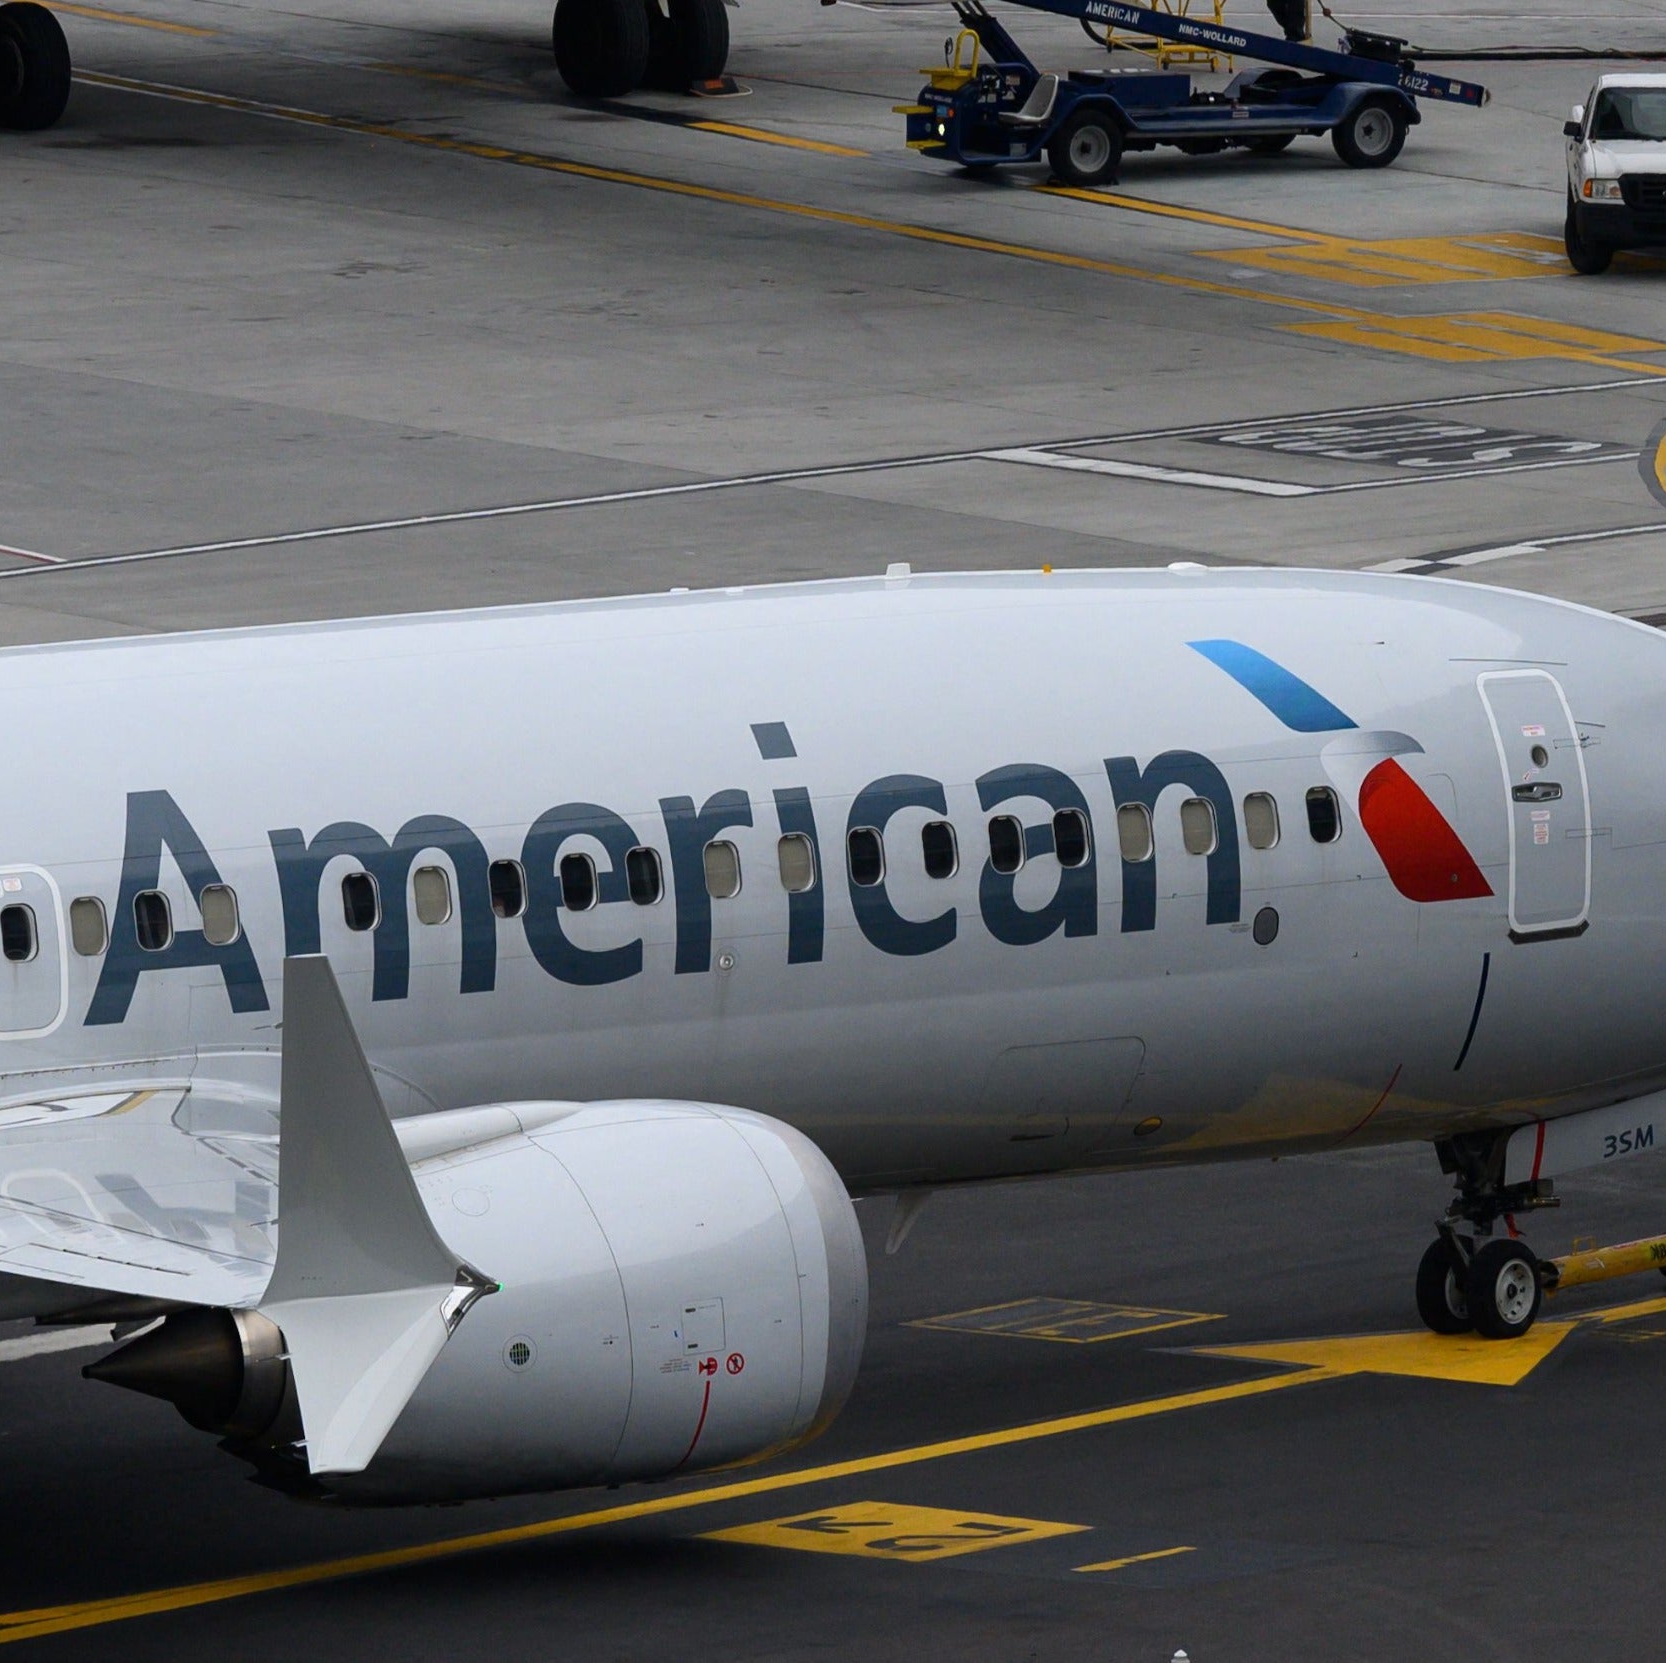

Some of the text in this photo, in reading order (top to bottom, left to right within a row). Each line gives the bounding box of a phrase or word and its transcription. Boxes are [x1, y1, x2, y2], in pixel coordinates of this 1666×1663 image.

[1085, 0, 1141, 25] AMERICAN
[1178, 23, 1248, 48] NMC-WOLLARD
[82, 720, 1241, 1027] American
[1603, 1124, 1654, 1158] 3SM
